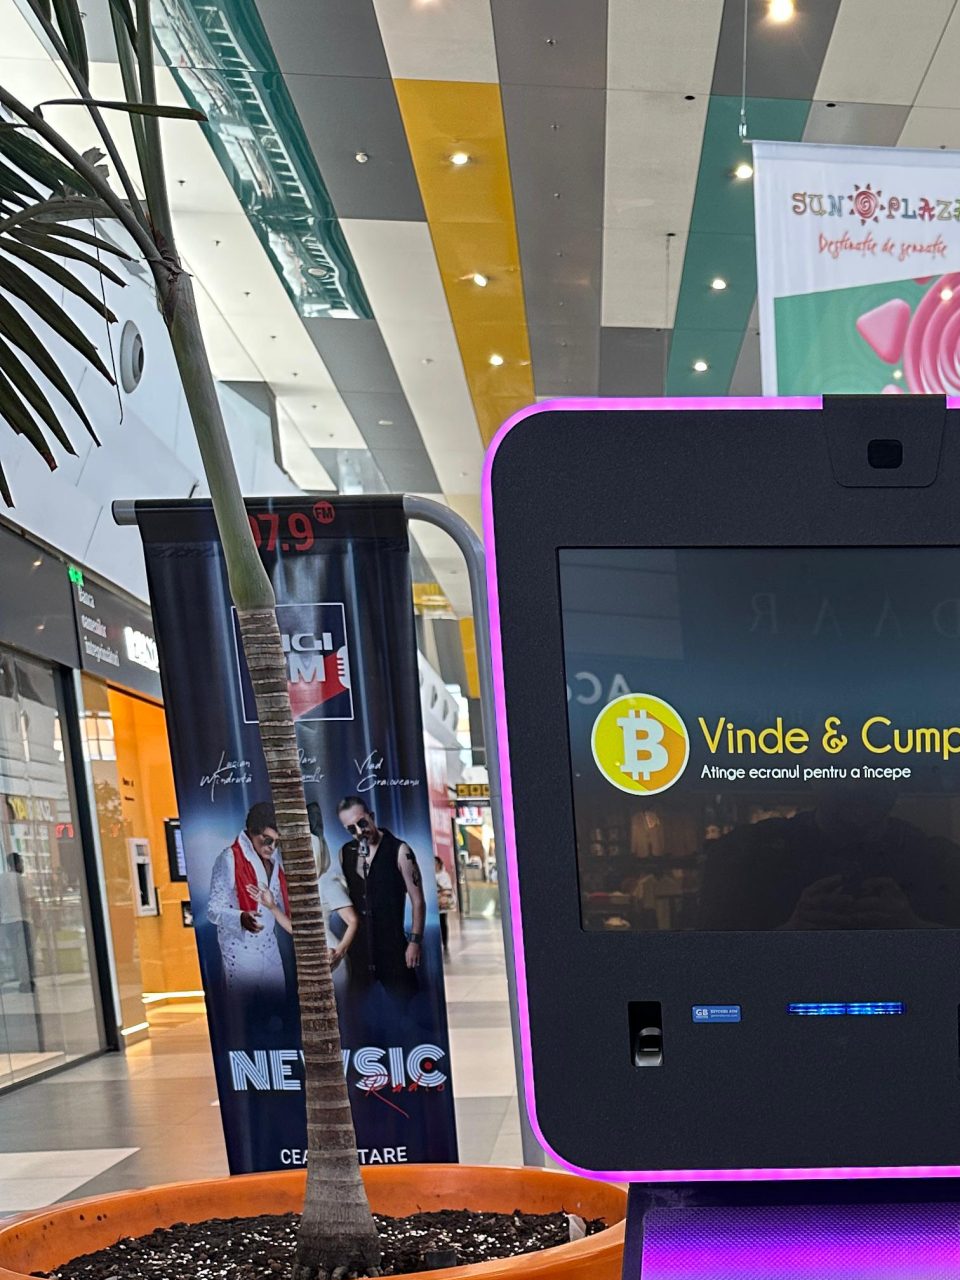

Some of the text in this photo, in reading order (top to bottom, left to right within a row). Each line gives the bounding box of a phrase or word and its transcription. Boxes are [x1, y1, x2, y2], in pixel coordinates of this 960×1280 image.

[792, 192, 844, 217] SUN
[315, 506, 333, 519] FM
[281, 632, 333, 652] IGI
[698, 716, 809, 754] Vinde
[822, 716, 848, 754] &
[701, 765, 912, 781] Atinge ecranul pentru a începe
[228, 1043, 448, 1091] NESIC
